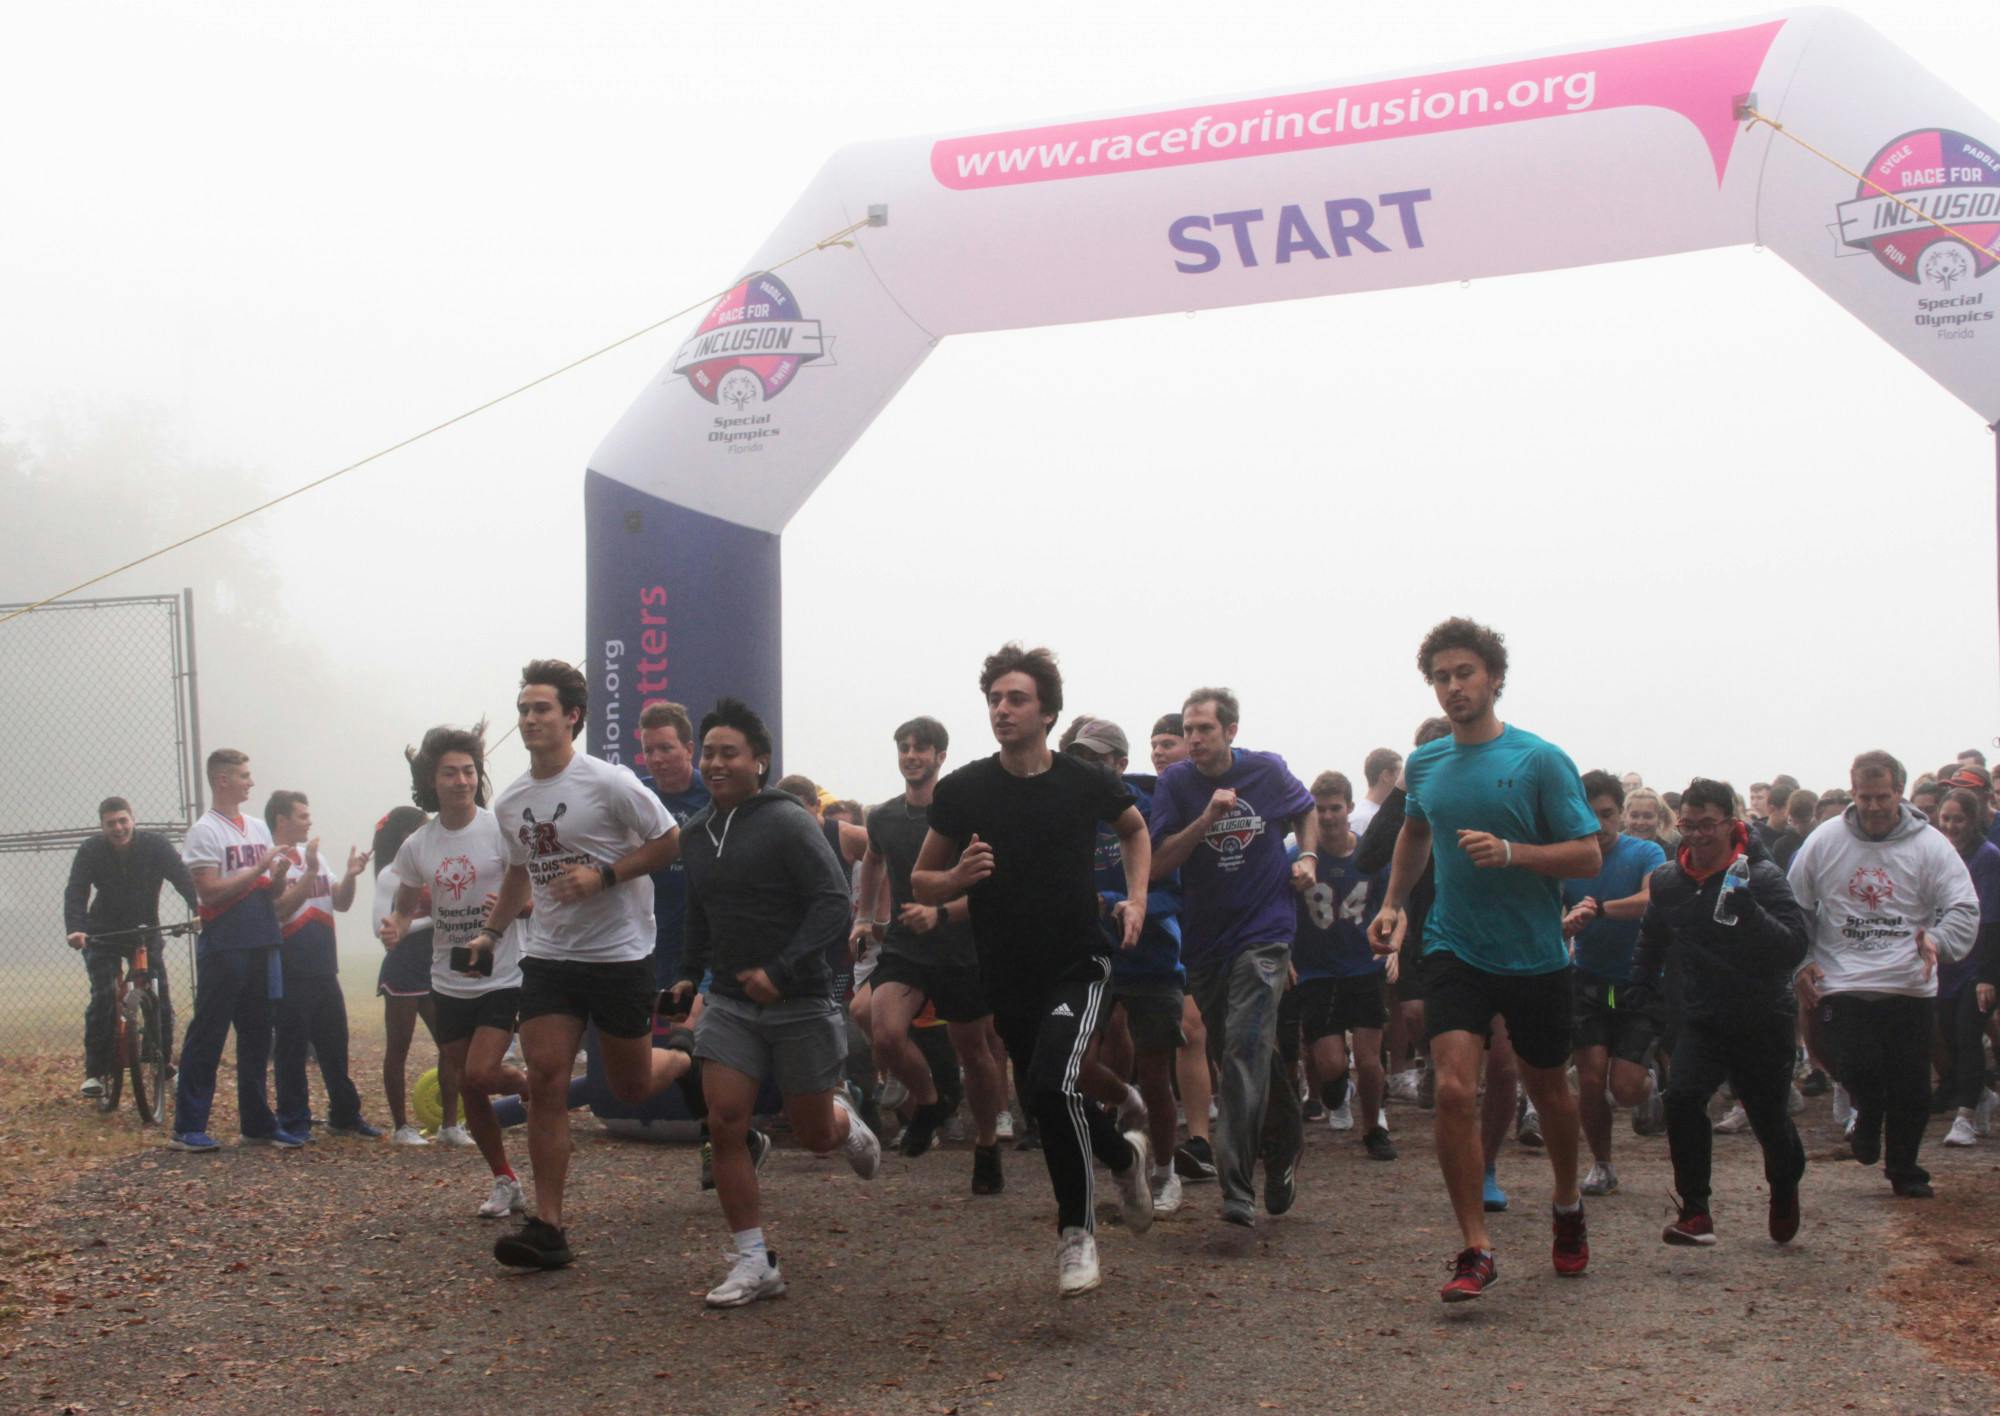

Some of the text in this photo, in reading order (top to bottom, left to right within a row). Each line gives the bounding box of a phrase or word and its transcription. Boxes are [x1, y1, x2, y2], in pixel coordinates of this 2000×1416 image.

[956, 67, 1597, 178] www.raceforinclusion.org
[1879, 145, 1913, 175] CYCLE
[1962, 144, 2000, 172] PADDLE
[1901, 167, 1983, 187] RACE FOR
[1167, 188, 1432, 274] START
[1884, 244, 1906, 265] RUN
[1918, 293, 1983, 311] Special
[718, 306, 745, 326] RACE
[747, 303, 770, 318] FOR
[1915, 310, 1994, 328] Olympics
[694, 327, 793, 358] INCLUSION
[1937, 328, 1975, 340] Florida
[714, 413, 771, 430] Special
[708, 427, 780, 444] Olympics
[728, 442, 764, 455] Florida
[1304, 881, 1369, 929] 84
